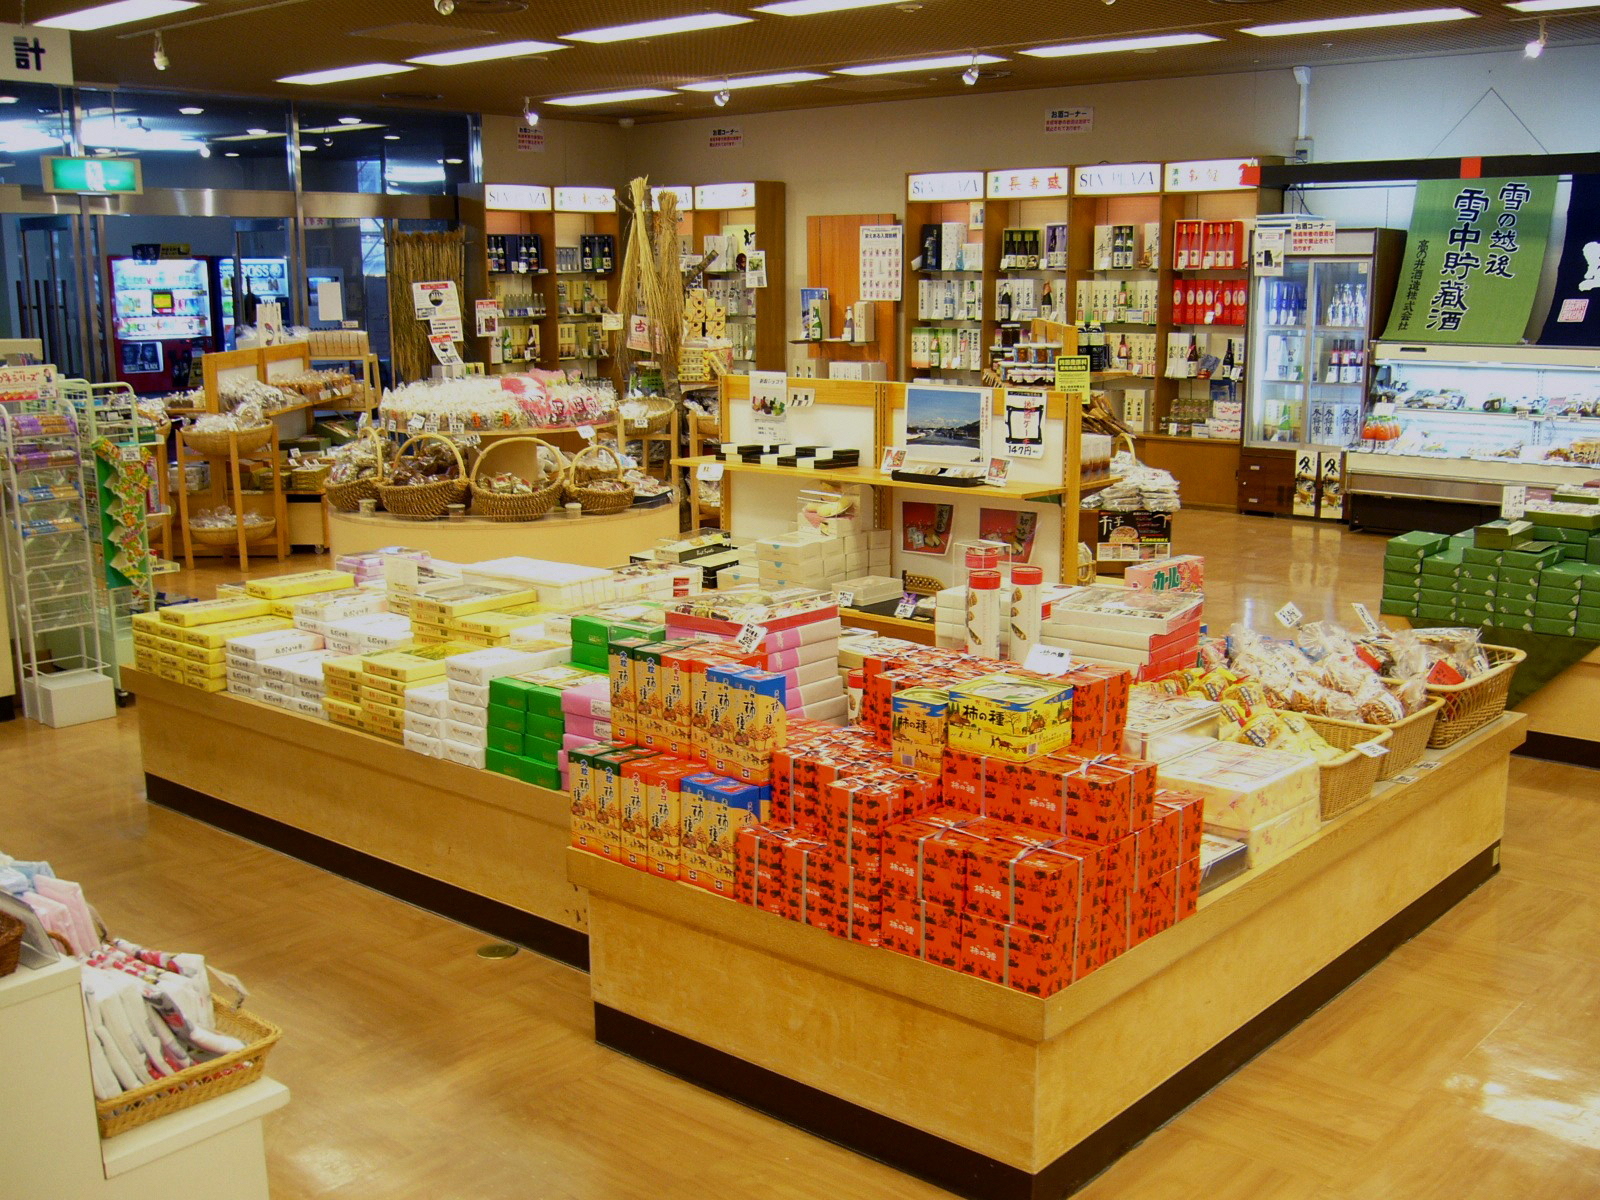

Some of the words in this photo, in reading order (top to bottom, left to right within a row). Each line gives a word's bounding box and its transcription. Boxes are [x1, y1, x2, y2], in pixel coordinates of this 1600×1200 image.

[13, 36, 46, 71] 計
[1485, 181, 1531, 279] 雪の越後
[1425, 188, 1490, 332] 雪中貯蔵酒
[1152, 566, 1182, 591] カール
[898, 715, 928, 734] 柿の種
[963, 705, 1005, 727] 柿の種
[951, 780, 976, 794] 柿の種
[1029, 798, 1056, 812] 柿の種
[890, 863, 914, 877] 柿の種
[974, 884, 1002, 900] 柿の種
[889, 922, 914, 935] 柿の種
[970, 945, 997, 961] 柿の種
